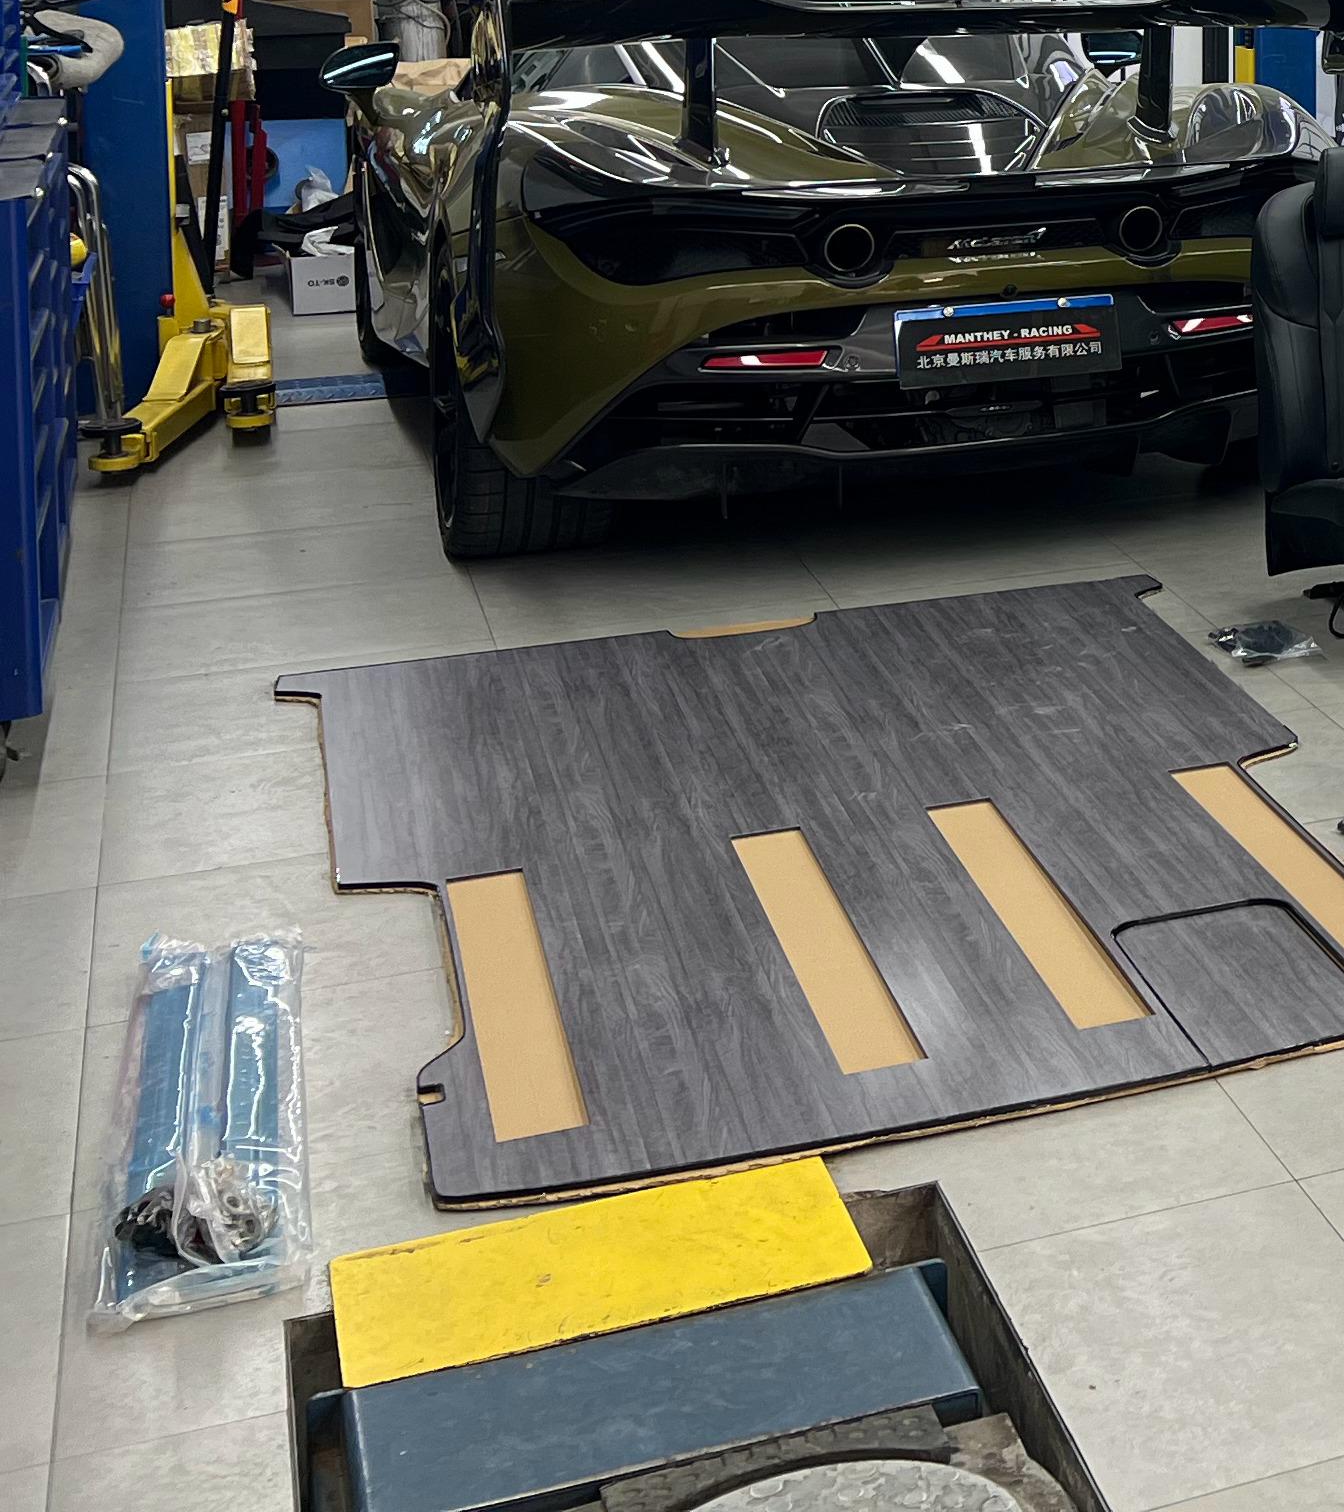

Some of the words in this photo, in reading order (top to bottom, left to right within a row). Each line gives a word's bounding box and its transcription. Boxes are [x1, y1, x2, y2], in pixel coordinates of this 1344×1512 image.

[944, 330, 1010, 345] MANTHEY
[1020, 325, 1073, 338] RACING
[916, 341, 1103, 370] 北京曼斯瑞汽车服务有限公司
